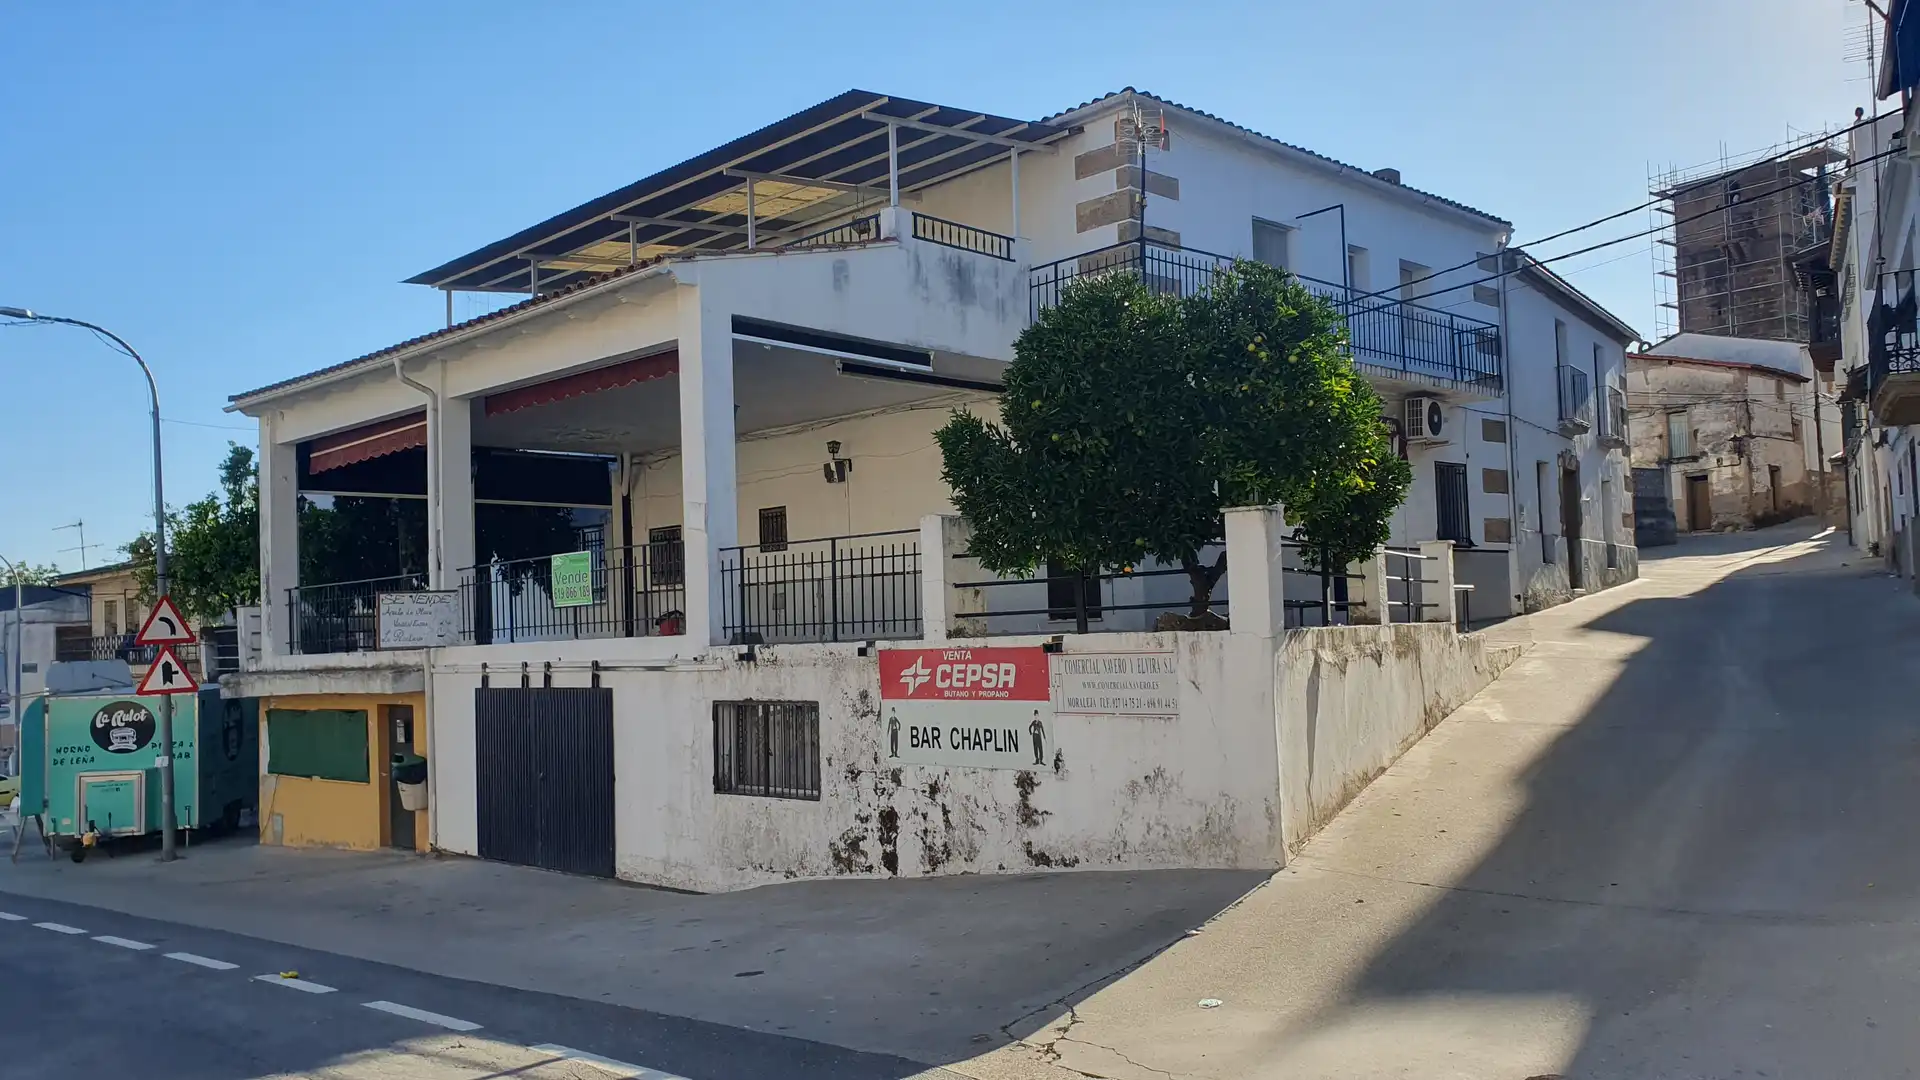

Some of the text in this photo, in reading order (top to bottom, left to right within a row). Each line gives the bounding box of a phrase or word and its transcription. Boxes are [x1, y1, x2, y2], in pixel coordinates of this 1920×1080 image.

[555, 570, 588, 585] Vende
[382, 593, 452, 607] SE VENDE
[942, 650, 972, 661] VENTA
[1064, 658, 1100, 675] COMERCIAL
[1103, 658, 1127, 674] NAVERO
[1137, 657, 1161, 674] ELVIRA
[935, 662, 1016, 688] CEPSA
[944, 690, 1009, 698] BUTANO Y PROPANO
[1067, 697, 1097, 708] MORALEJA
[95, 708, 149, 729] La Rulot
[151, 741, 184, 750] PIZA
[910, 726, 1019, 753] BAR CHAPLIN
[55, 744, 91, 754] HORNO
[53, 754, 95, 766] DE LEÑA
